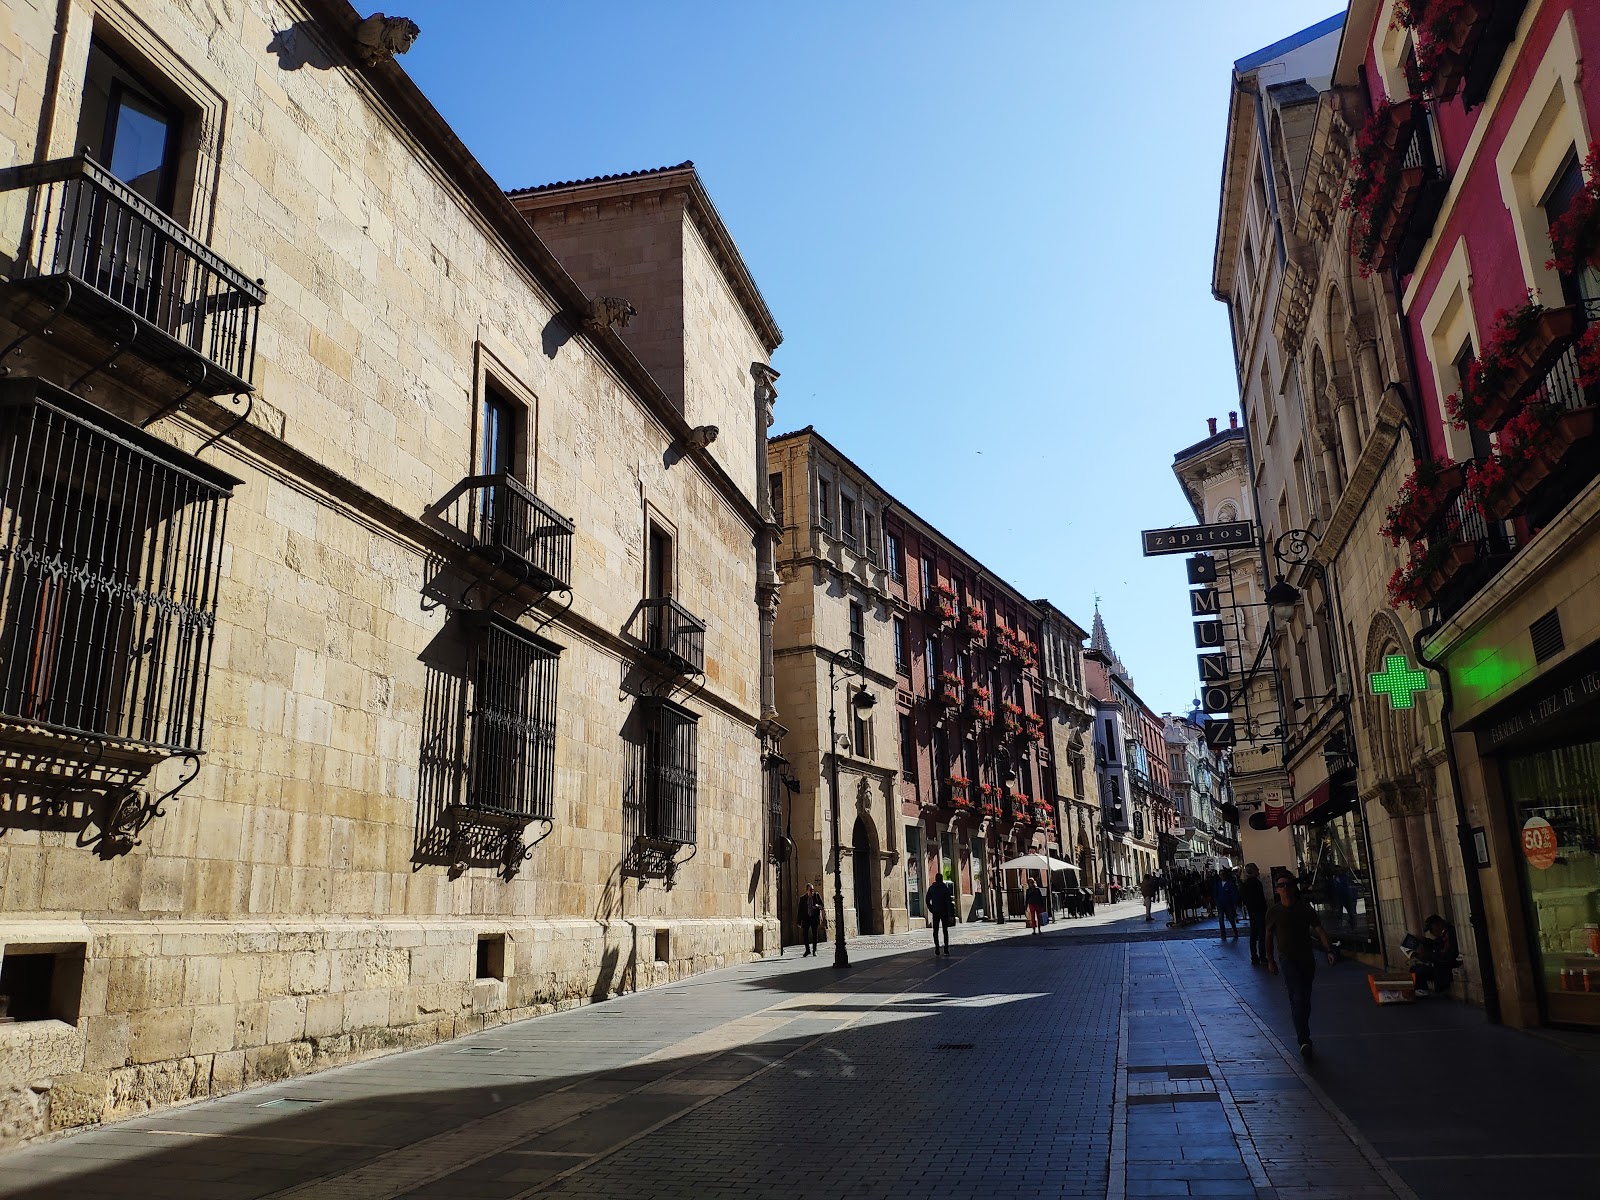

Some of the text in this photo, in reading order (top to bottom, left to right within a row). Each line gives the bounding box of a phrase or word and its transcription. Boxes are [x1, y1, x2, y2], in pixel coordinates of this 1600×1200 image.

[1155, 527, 1243, 545] zapatos
[1193, 592, 1232, 744] MUÑOZ
[1491, 716, 1524, 743] FARMACIA
[1563, 686, 1576, 706] DE
